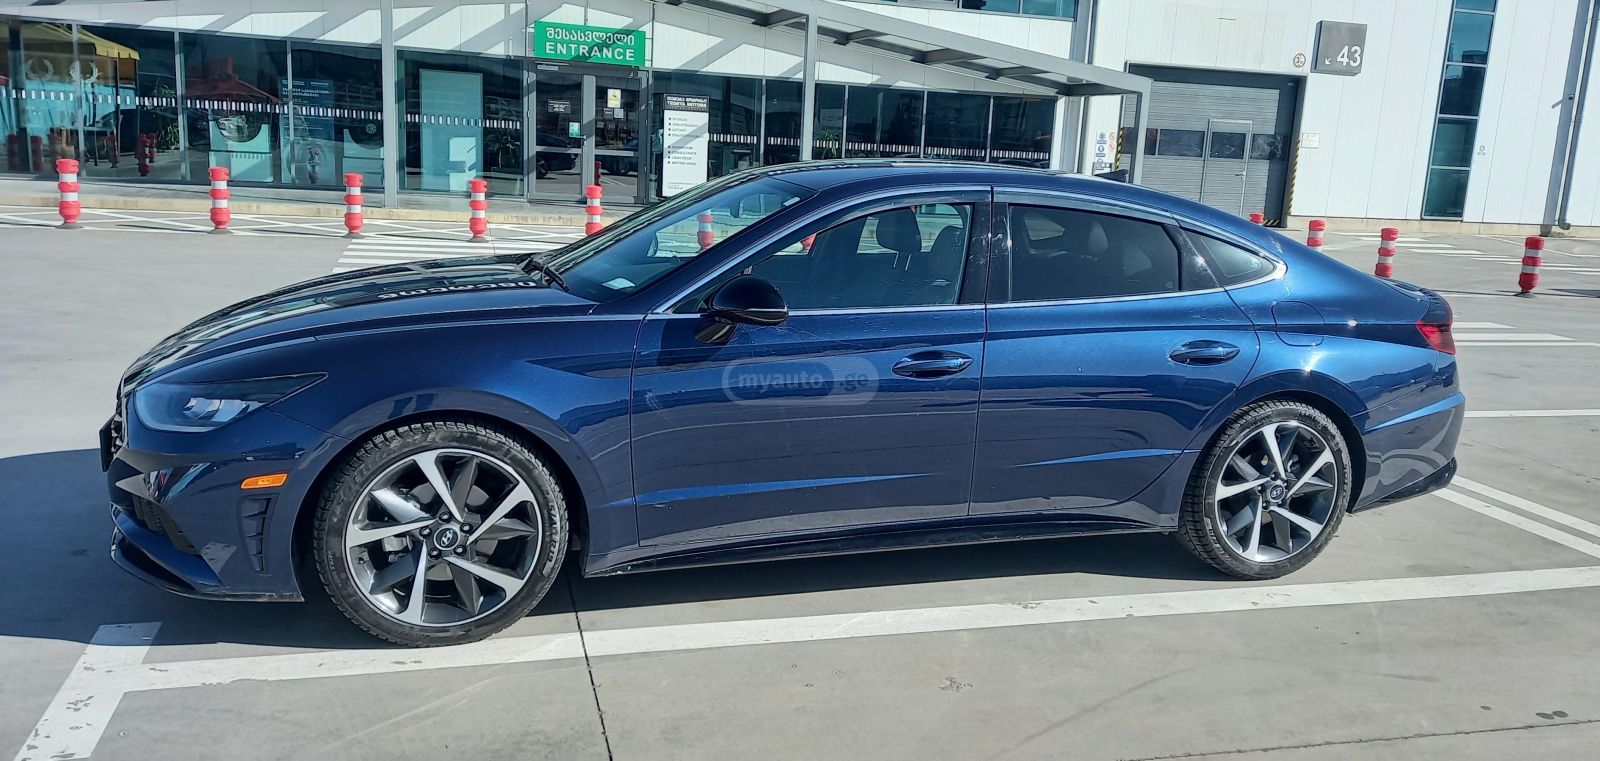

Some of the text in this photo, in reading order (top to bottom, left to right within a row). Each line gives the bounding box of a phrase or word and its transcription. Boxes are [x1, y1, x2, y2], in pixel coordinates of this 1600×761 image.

[546, 27, 635, 46] შესასვლელი
[545, 41, 635, 61] ENTRANCE
[1336, 45, 1362, 67] 43
